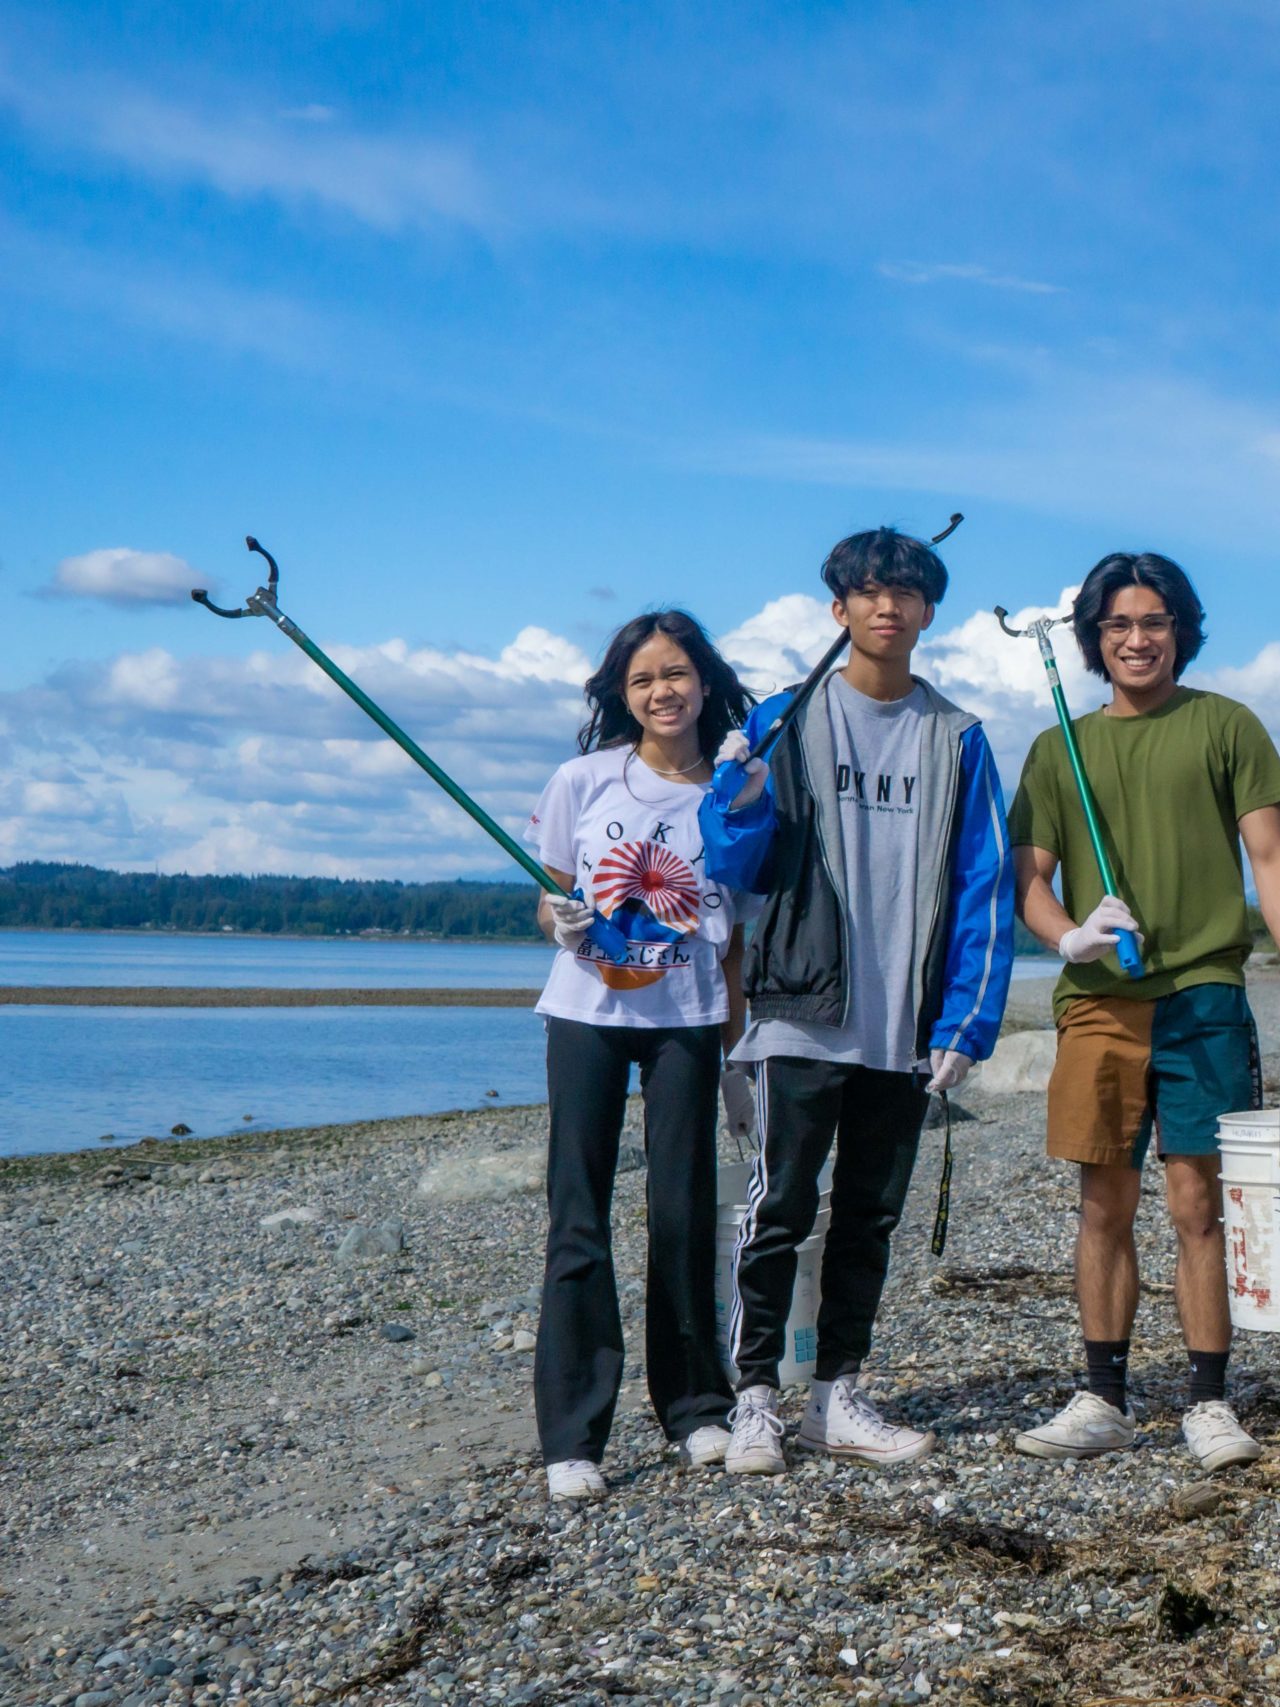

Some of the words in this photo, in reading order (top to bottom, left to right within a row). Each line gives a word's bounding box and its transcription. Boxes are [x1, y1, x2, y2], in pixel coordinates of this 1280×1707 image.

[837, 764, 916, 804] DKNY
[877, 805, 895, 813] New
[896, 806, 914, 814] York
